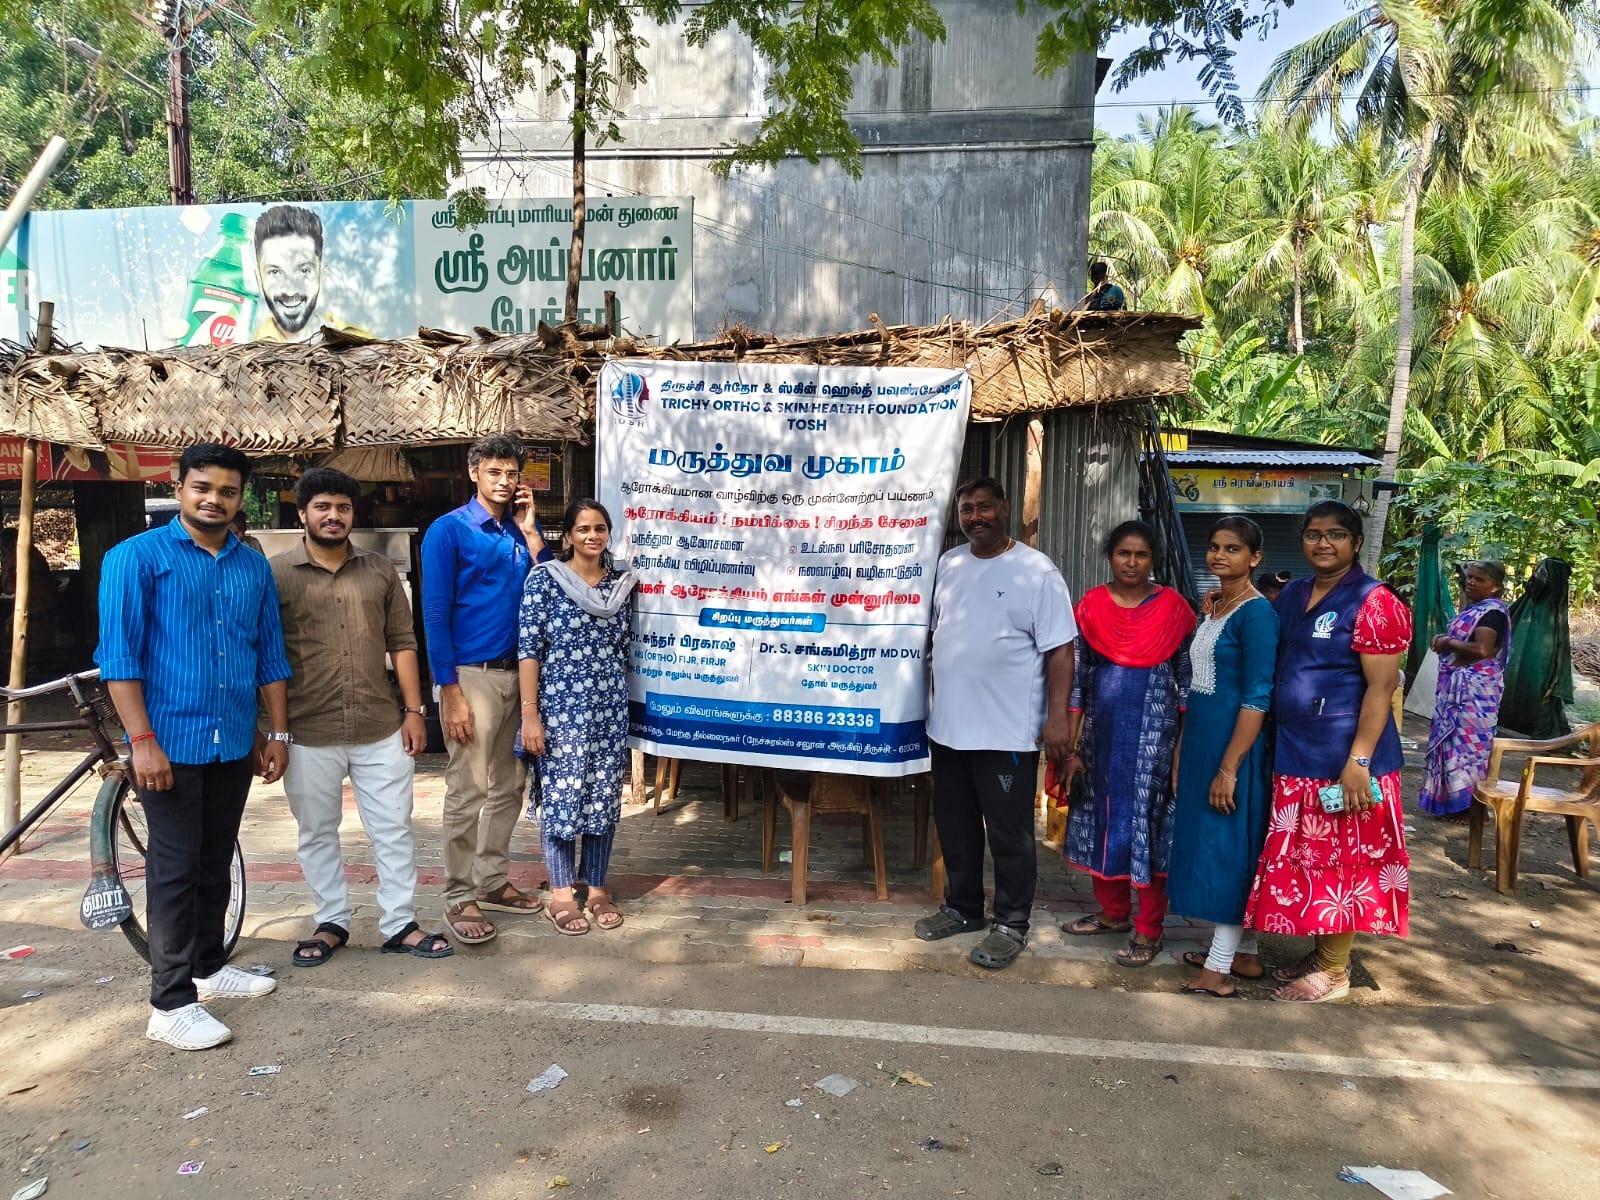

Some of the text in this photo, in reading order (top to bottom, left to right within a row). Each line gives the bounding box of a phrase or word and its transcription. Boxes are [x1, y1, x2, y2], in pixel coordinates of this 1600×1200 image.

[618, 206, 680, 228] துணை
[435, 233, 489, 294] ஸ்ரீ
[660, 380, 705, 393] திருச்சி
[709, 382, 758, 395] ஆர்தோ
[763, 384, 773, 394] &
[778, 380, 817, 396] ஸ்கின்
[821, 383, 872, 398] ஹெல்த்
[660, 398, 959, 415] TRICHY ORTHO & SKIN HEALTH FOUNDATION
[787, 418, 827, 431] TOSH
[648, 442, 906, 480] மருத்துவ முகாம்
[620, 481, 713, 499] ஆரோக்கியமான
[716, 488, 779, 504] வாழ்விற்கு
[781, 493, 805, 505] ஒரு
[887, 488, 934, 502] பயணம்
[623, 506, 718, 525] ஆரோக்கியம்
[730, 513, 811, 529] நம்பிக்கை
[824, 514, 874, 531] சிறந்த
[877, 515, 928, 529] சேவை
[676, 535, 744, 551] ஆலோசனை
[800, 541, 915, 557] உடல்நல பரிசோதனை
[631, 554, 756, 577] ஆரோக்கிய விழிப்புணர்வு
[798, 562, 923, 581] நலவாழ்வு வழிகாட்டுதல்
[633, 579, 666, 595] ங்கள்
[772, 589, 826, 604] எங்கள்
[830, 589, 921, 612] முன்னுரிமை
[711, 611, 813, 628] சிறப்பு மருத்துவர்கள்
[680, 634, 736, 653] பிரகாஷ்
[759, 642, 920, 661] Dr. S. சங்கமித்ரா MD DVL
[644, 649, 677, 664] (ORTHO)
[700, 657, 727, 667] FIRJR
[807, 663, 874, 675] SKIN DOCTOR
[801, 678, 878, 692] தோல் மருத்துவர்
[649, 701, 682, 717] மேலும்
[684, 704, 763, 722] விவரங்களுக்கு
[773, 708, 824, 724] 88386
[826, 711, 874, 727] 23336
